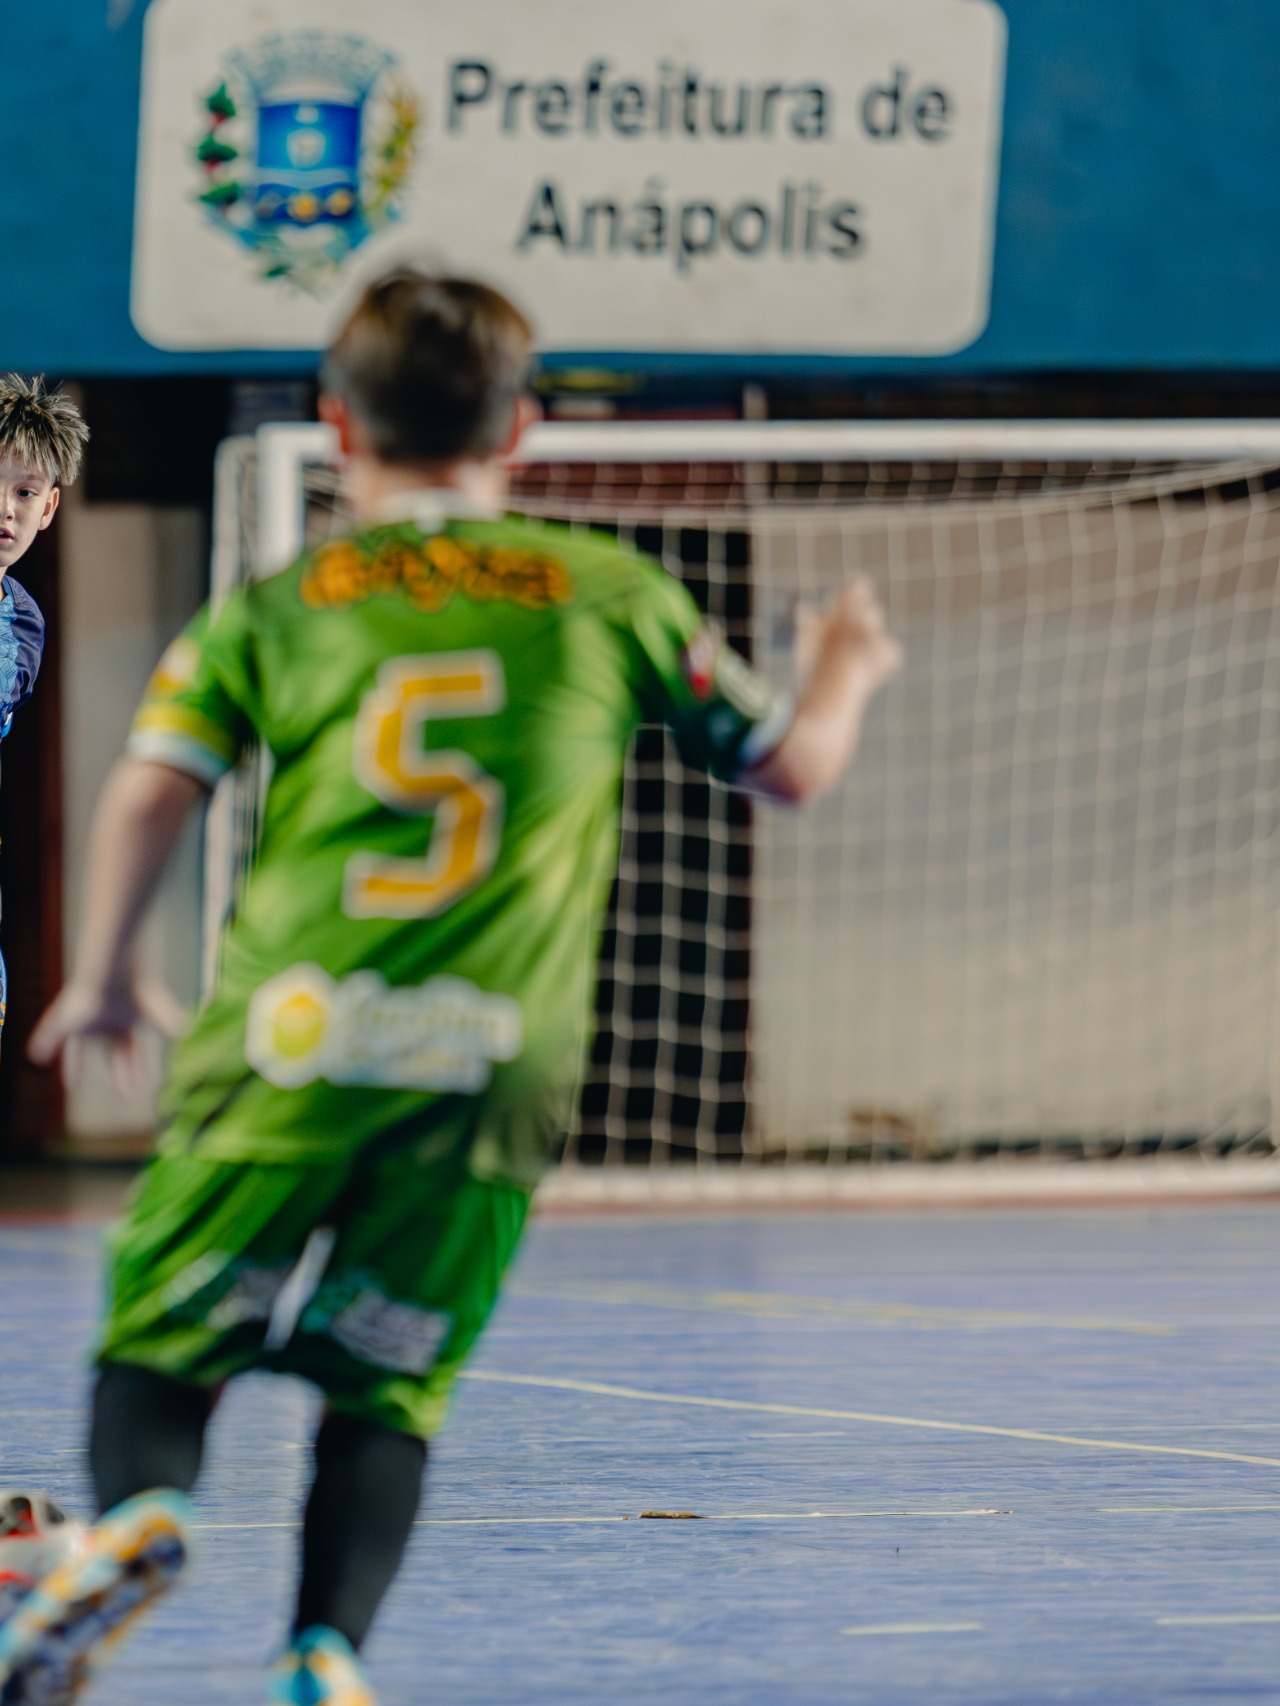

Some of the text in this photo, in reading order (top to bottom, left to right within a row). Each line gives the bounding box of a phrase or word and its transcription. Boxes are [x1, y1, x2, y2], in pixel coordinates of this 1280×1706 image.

[445, 60, 954, 140] Prefeitura de
[519, 178, 866, 274] Anápolis
[342, 650, 503, 918] 5
